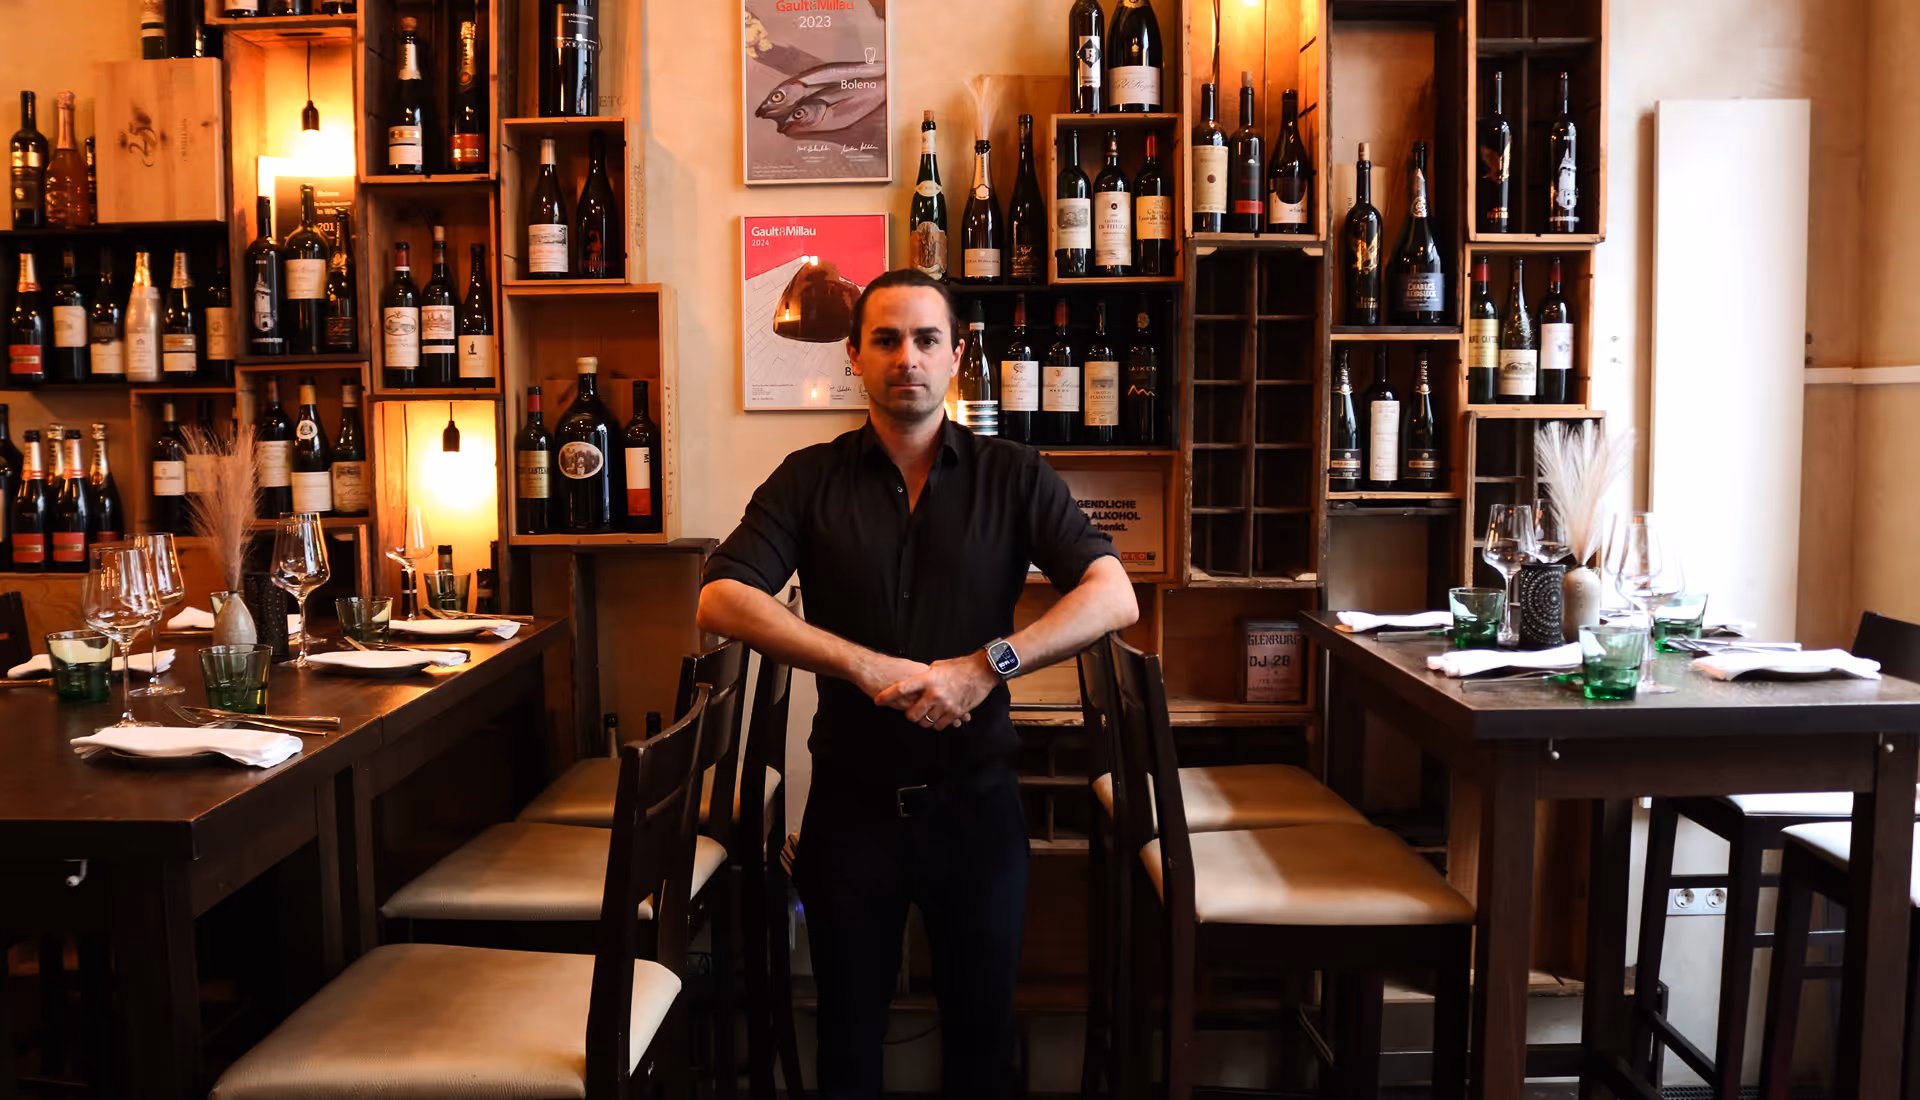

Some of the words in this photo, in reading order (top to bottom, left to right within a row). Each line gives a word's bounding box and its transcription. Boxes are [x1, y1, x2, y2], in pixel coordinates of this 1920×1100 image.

[799, 16, 832, 28] 2023
[840, 79, 877, 90] Bolena
[751, 226, 816, 237] Gault&Millau
[751, 239, 770, 247] 2024
[1077, 499, 1137, 509] GENDLICHE
[1091, 511, 1141, 521] ALKOHOL
[1093, 522, 1128, 532] henkt.
